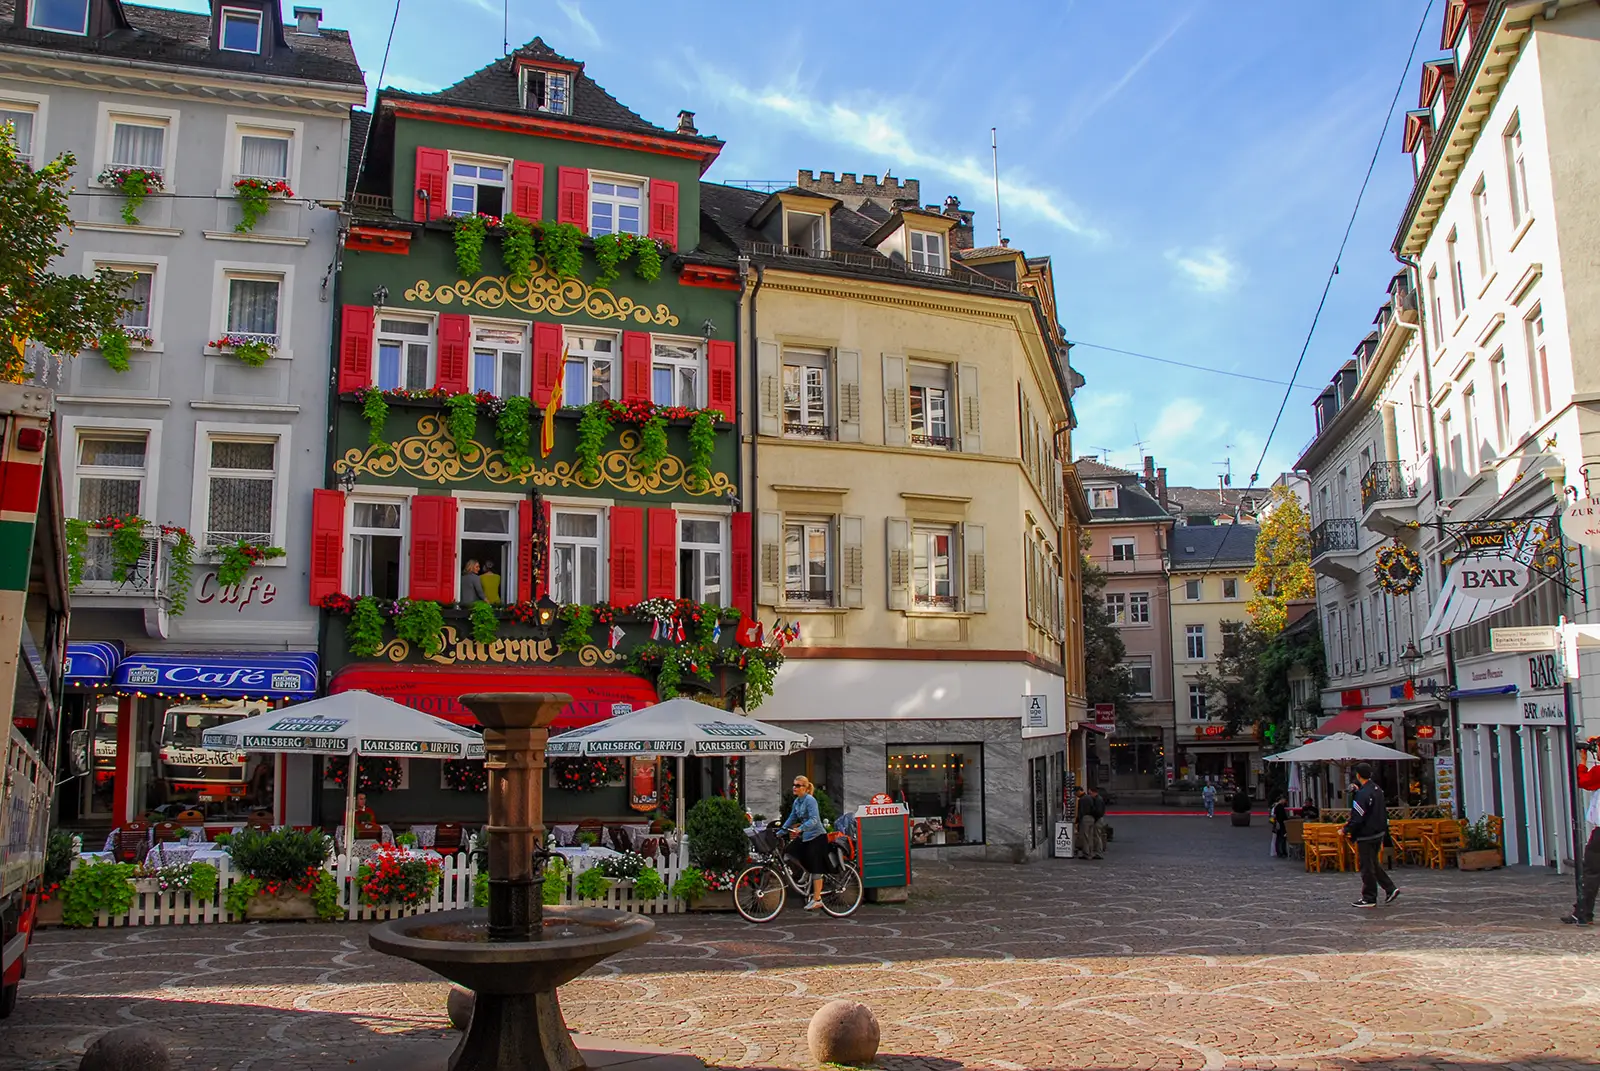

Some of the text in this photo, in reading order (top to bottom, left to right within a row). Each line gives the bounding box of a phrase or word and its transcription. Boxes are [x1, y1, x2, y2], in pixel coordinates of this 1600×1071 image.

[1571, 508, 1594, 517] ZUR
[1470, 535, 1504, 545] KRANZ
[1461, 569, 1519, 588] BÄR
[1528, 654, 1558, 688] BÄR
[164, 666, 266, 688] Café
[1030, 698, 1041, 709] A
[275, 723, 337, 731] UR-PILS
[245, 736, 346, 749] KARLSBERG UR-PILS
[363, 740, 418, 751] KARLSBERG
[430, 742, 459, 753] UR-PILS
[589, 741, 641, 751] KARLSBERG
[654, 741, 682, 751] UR-PILS
[698, 741, 747, 751] KARLSBERG
[758, 741, 783, 750] UR-PILS
[865, 806, 899, 815] Laterne
[1057, 826, 1070, 839] A
